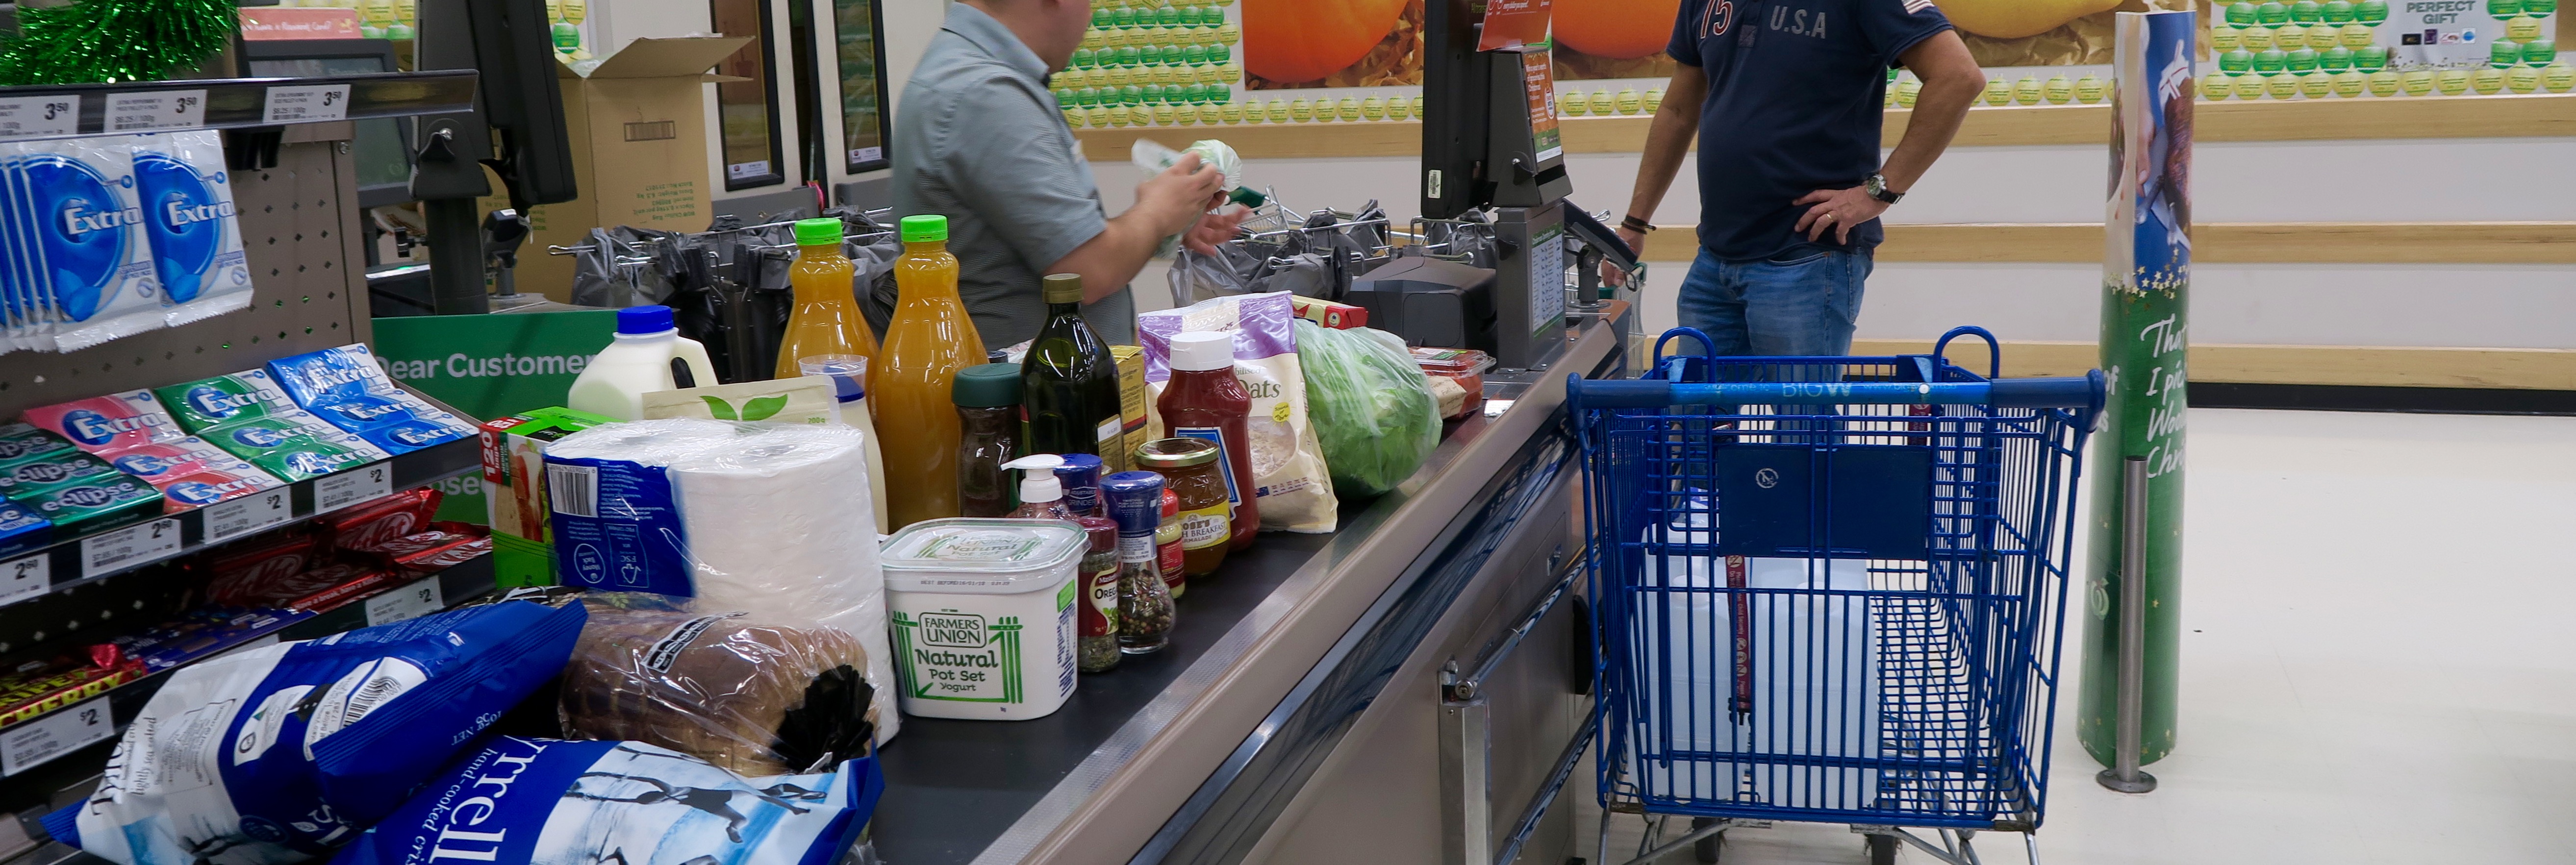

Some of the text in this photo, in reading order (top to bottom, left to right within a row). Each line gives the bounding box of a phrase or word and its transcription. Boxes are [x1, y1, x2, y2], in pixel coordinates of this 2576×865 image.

[2407, 0, 2475, 13] PERFECT
[1770, 5, 1826, 39] U.S.A
[2423, 13, 2459, 24] GIFT
[64, 207, 142, 235] Extra
[167, 201, 236, 226] Extra
[446, 353, 597, 378] Customer
[197, 388, 282, 413] Extra
[347, 400, 425, 419] Extra
[73, 413, 168, 439] Extra
[244, 423, 328, 445] Extra
[397, 424, 475, 444] Extra
[126, 449, 220, 472] Extra
[481, 431, 497, 476] 120
[0, 459, 92, 487] eclipse
[41, 482, 134, 511] eclipse
[177, 475, 271, 501] Extra
[1182, 519, 1210, 531] OSE'S
[1191, 521, 1226, 537] BREAKFAST
[947, 544, 1017, 552] Natural
[925, 618, 980, 630] FARMERS
[926, 629, 981, 644] UNION
[914, 648, 999, 668] Natural
[929, 668, 986, 682] Pot Set
[940, 682, 977, 692] Yogurt
[451, 727, 474, 745] NET
[422, 748, 499, 832] hand-cooked
